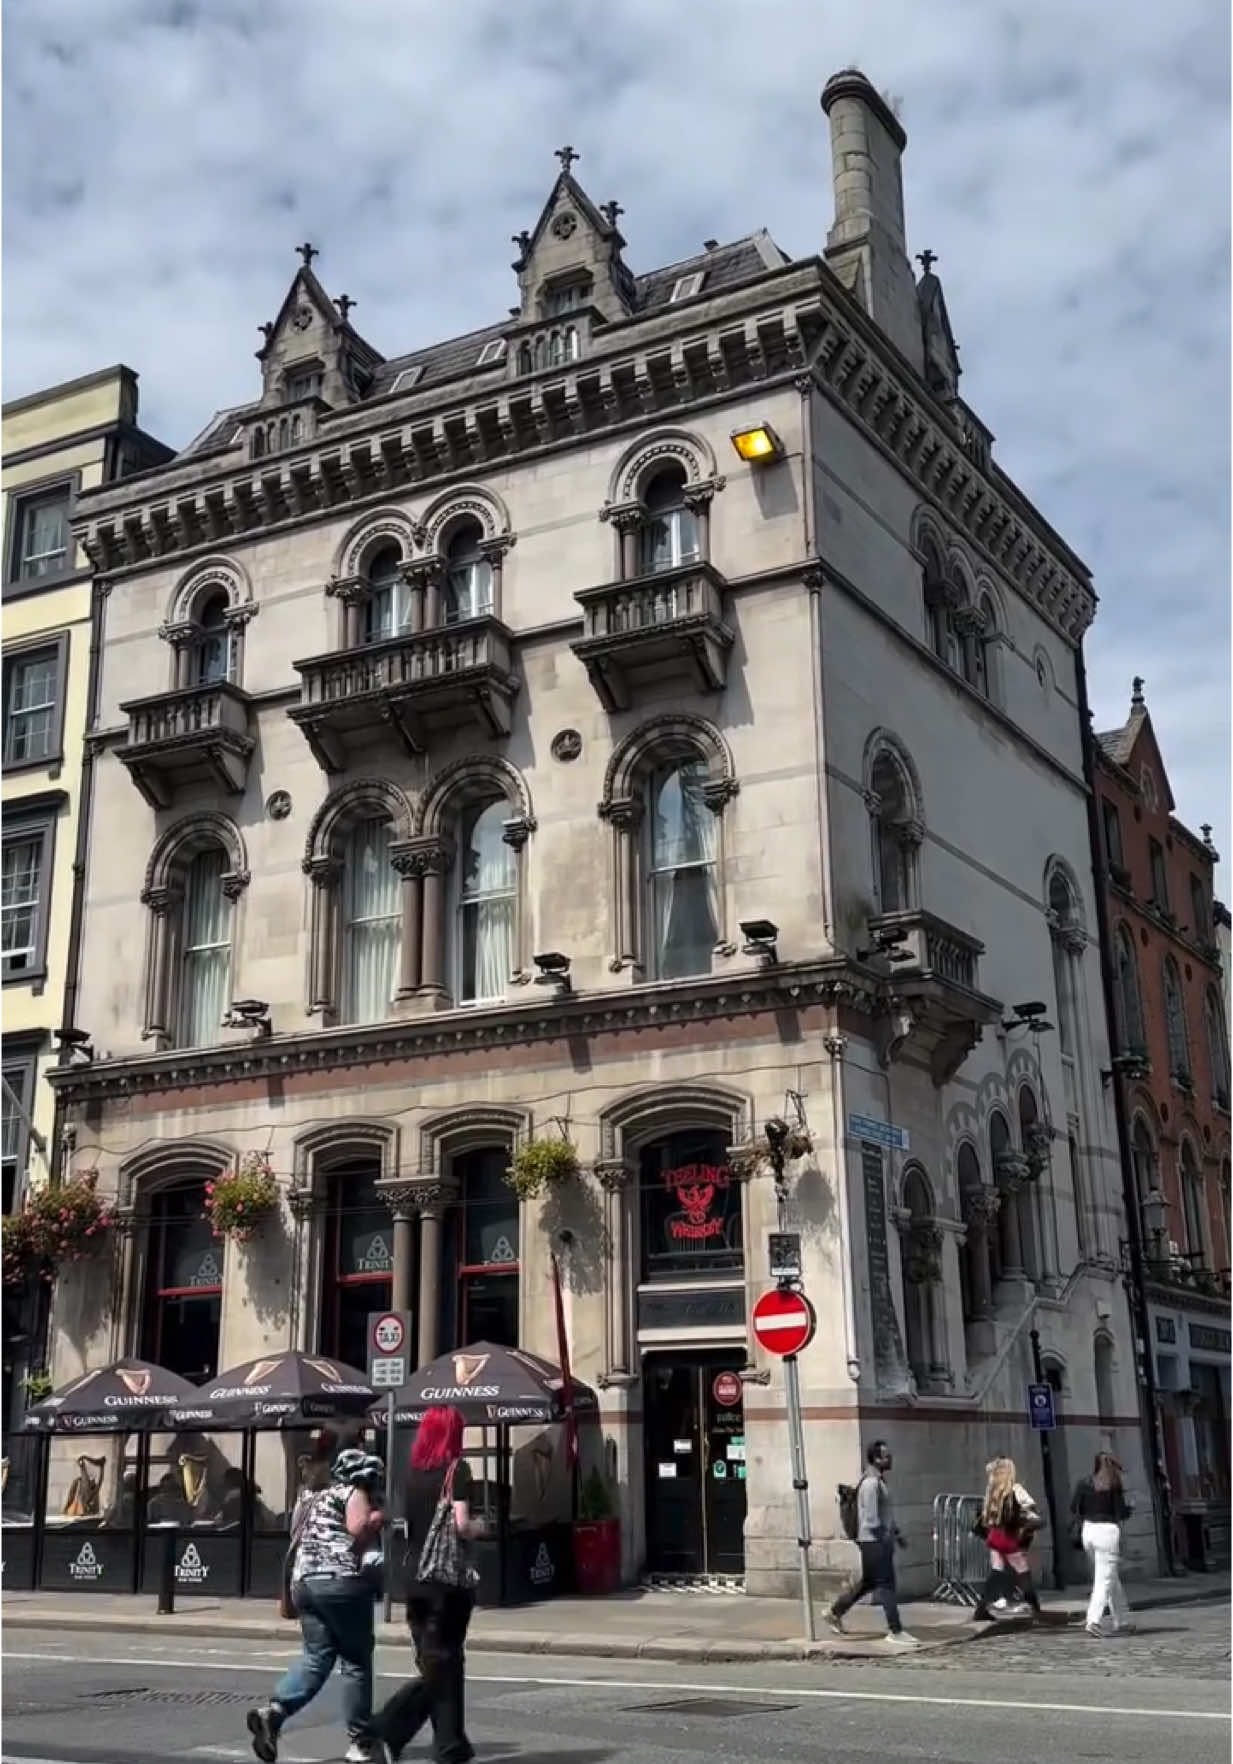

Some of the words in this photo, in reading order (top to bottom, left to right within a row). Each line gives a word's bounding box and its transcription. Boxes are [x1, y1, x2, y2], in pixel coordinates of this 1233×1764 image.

[420, 1385, 500, 1400] GUINNESS
[103, 1395, 179, 1406] GUINNESS
[496, 1406, 544, 1418] GUINNESS
[69, 1563, 104, 1575] TRINITY
[174, 1564, 209, 1577] TRINITY
